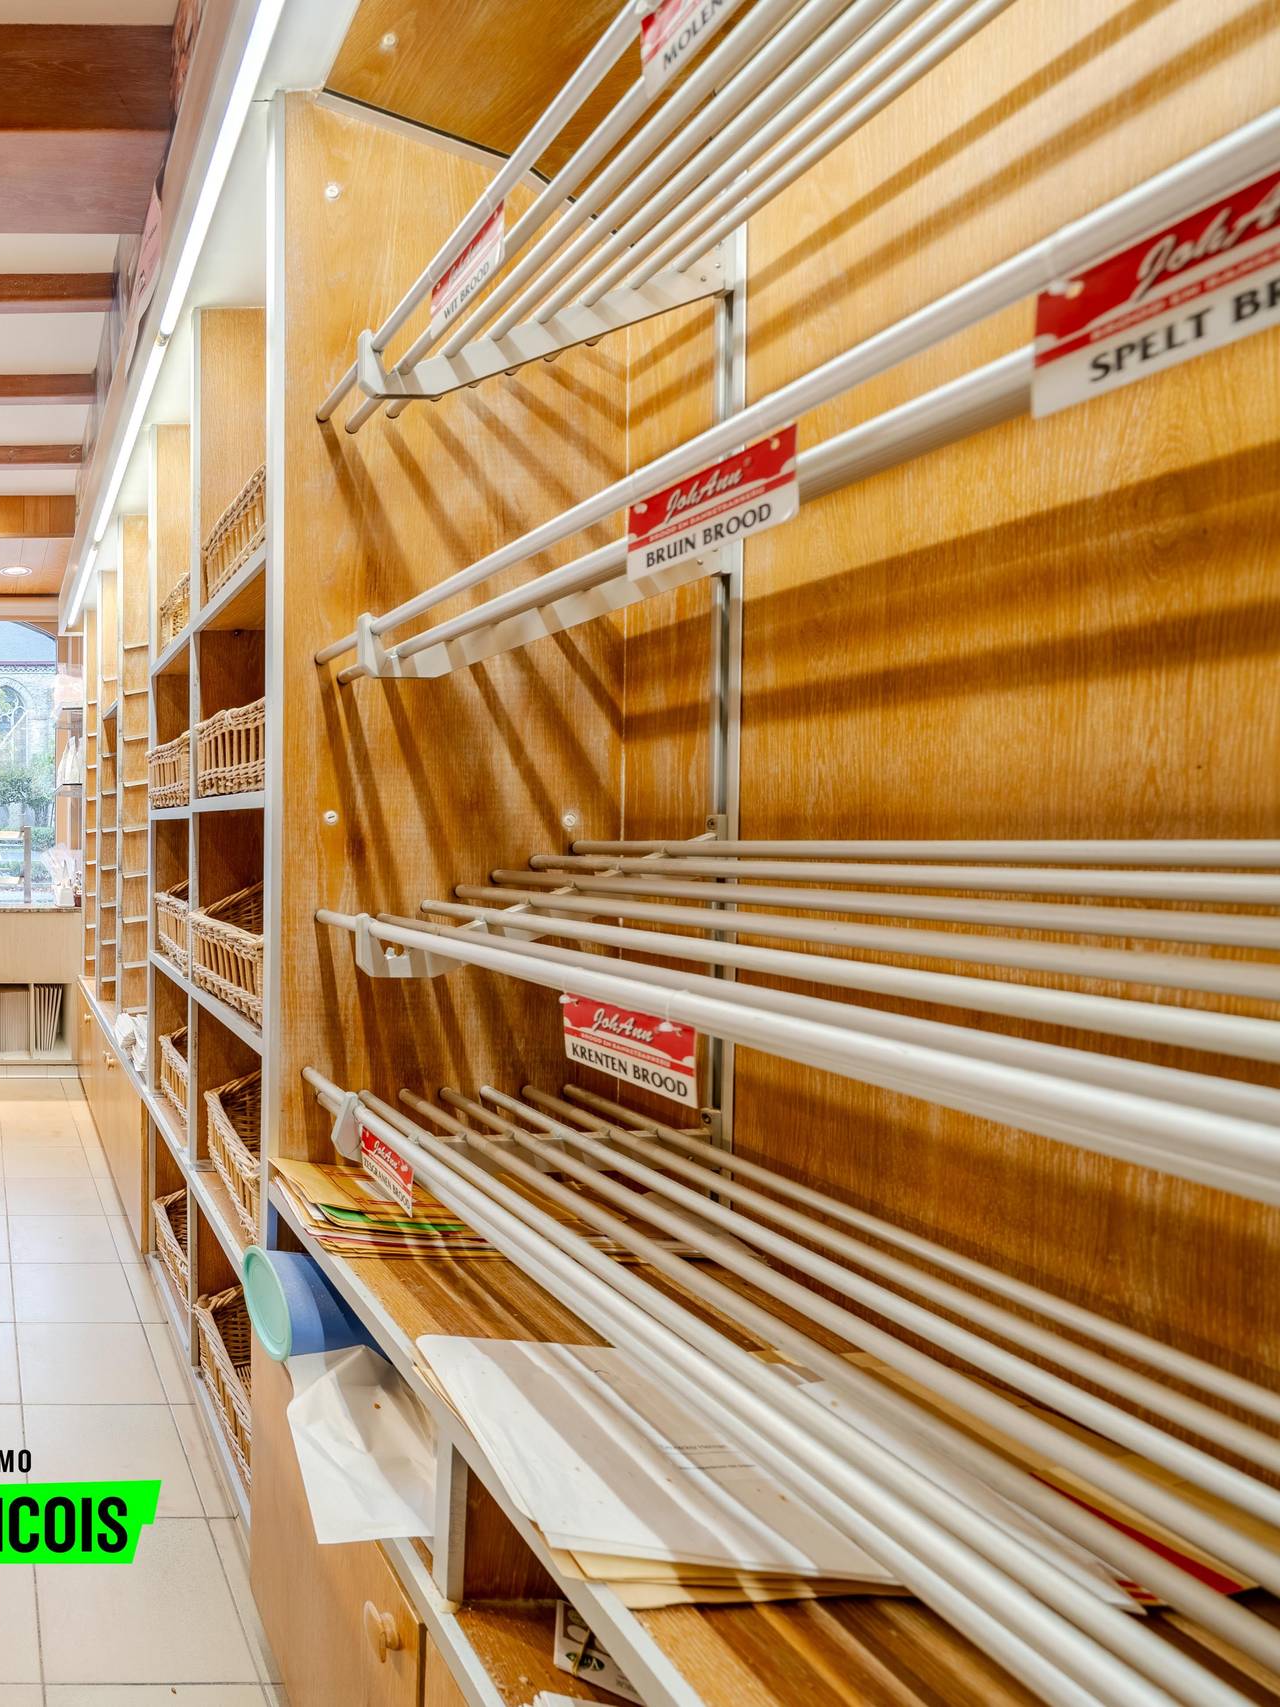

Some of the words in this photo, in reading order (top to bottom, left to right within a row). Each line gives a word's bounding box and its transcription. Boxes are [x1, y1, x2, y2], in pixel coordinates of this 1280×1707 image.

[443, 300, 459, 320] WIT
[460, 262, 490, 302] BROOD
[1089, 307, 1215, 383] SPELT
[665, 468, 743, 524] JohAnn
[646, 533, 696, 568] BRUIN
[703, 503, 771, 545] BROOD
[591, 1008, 653, 1042] JohAnn
[572, 1042, 628, 1076] KRENTEN
[632, 1064, 688, 1098] BROOD
